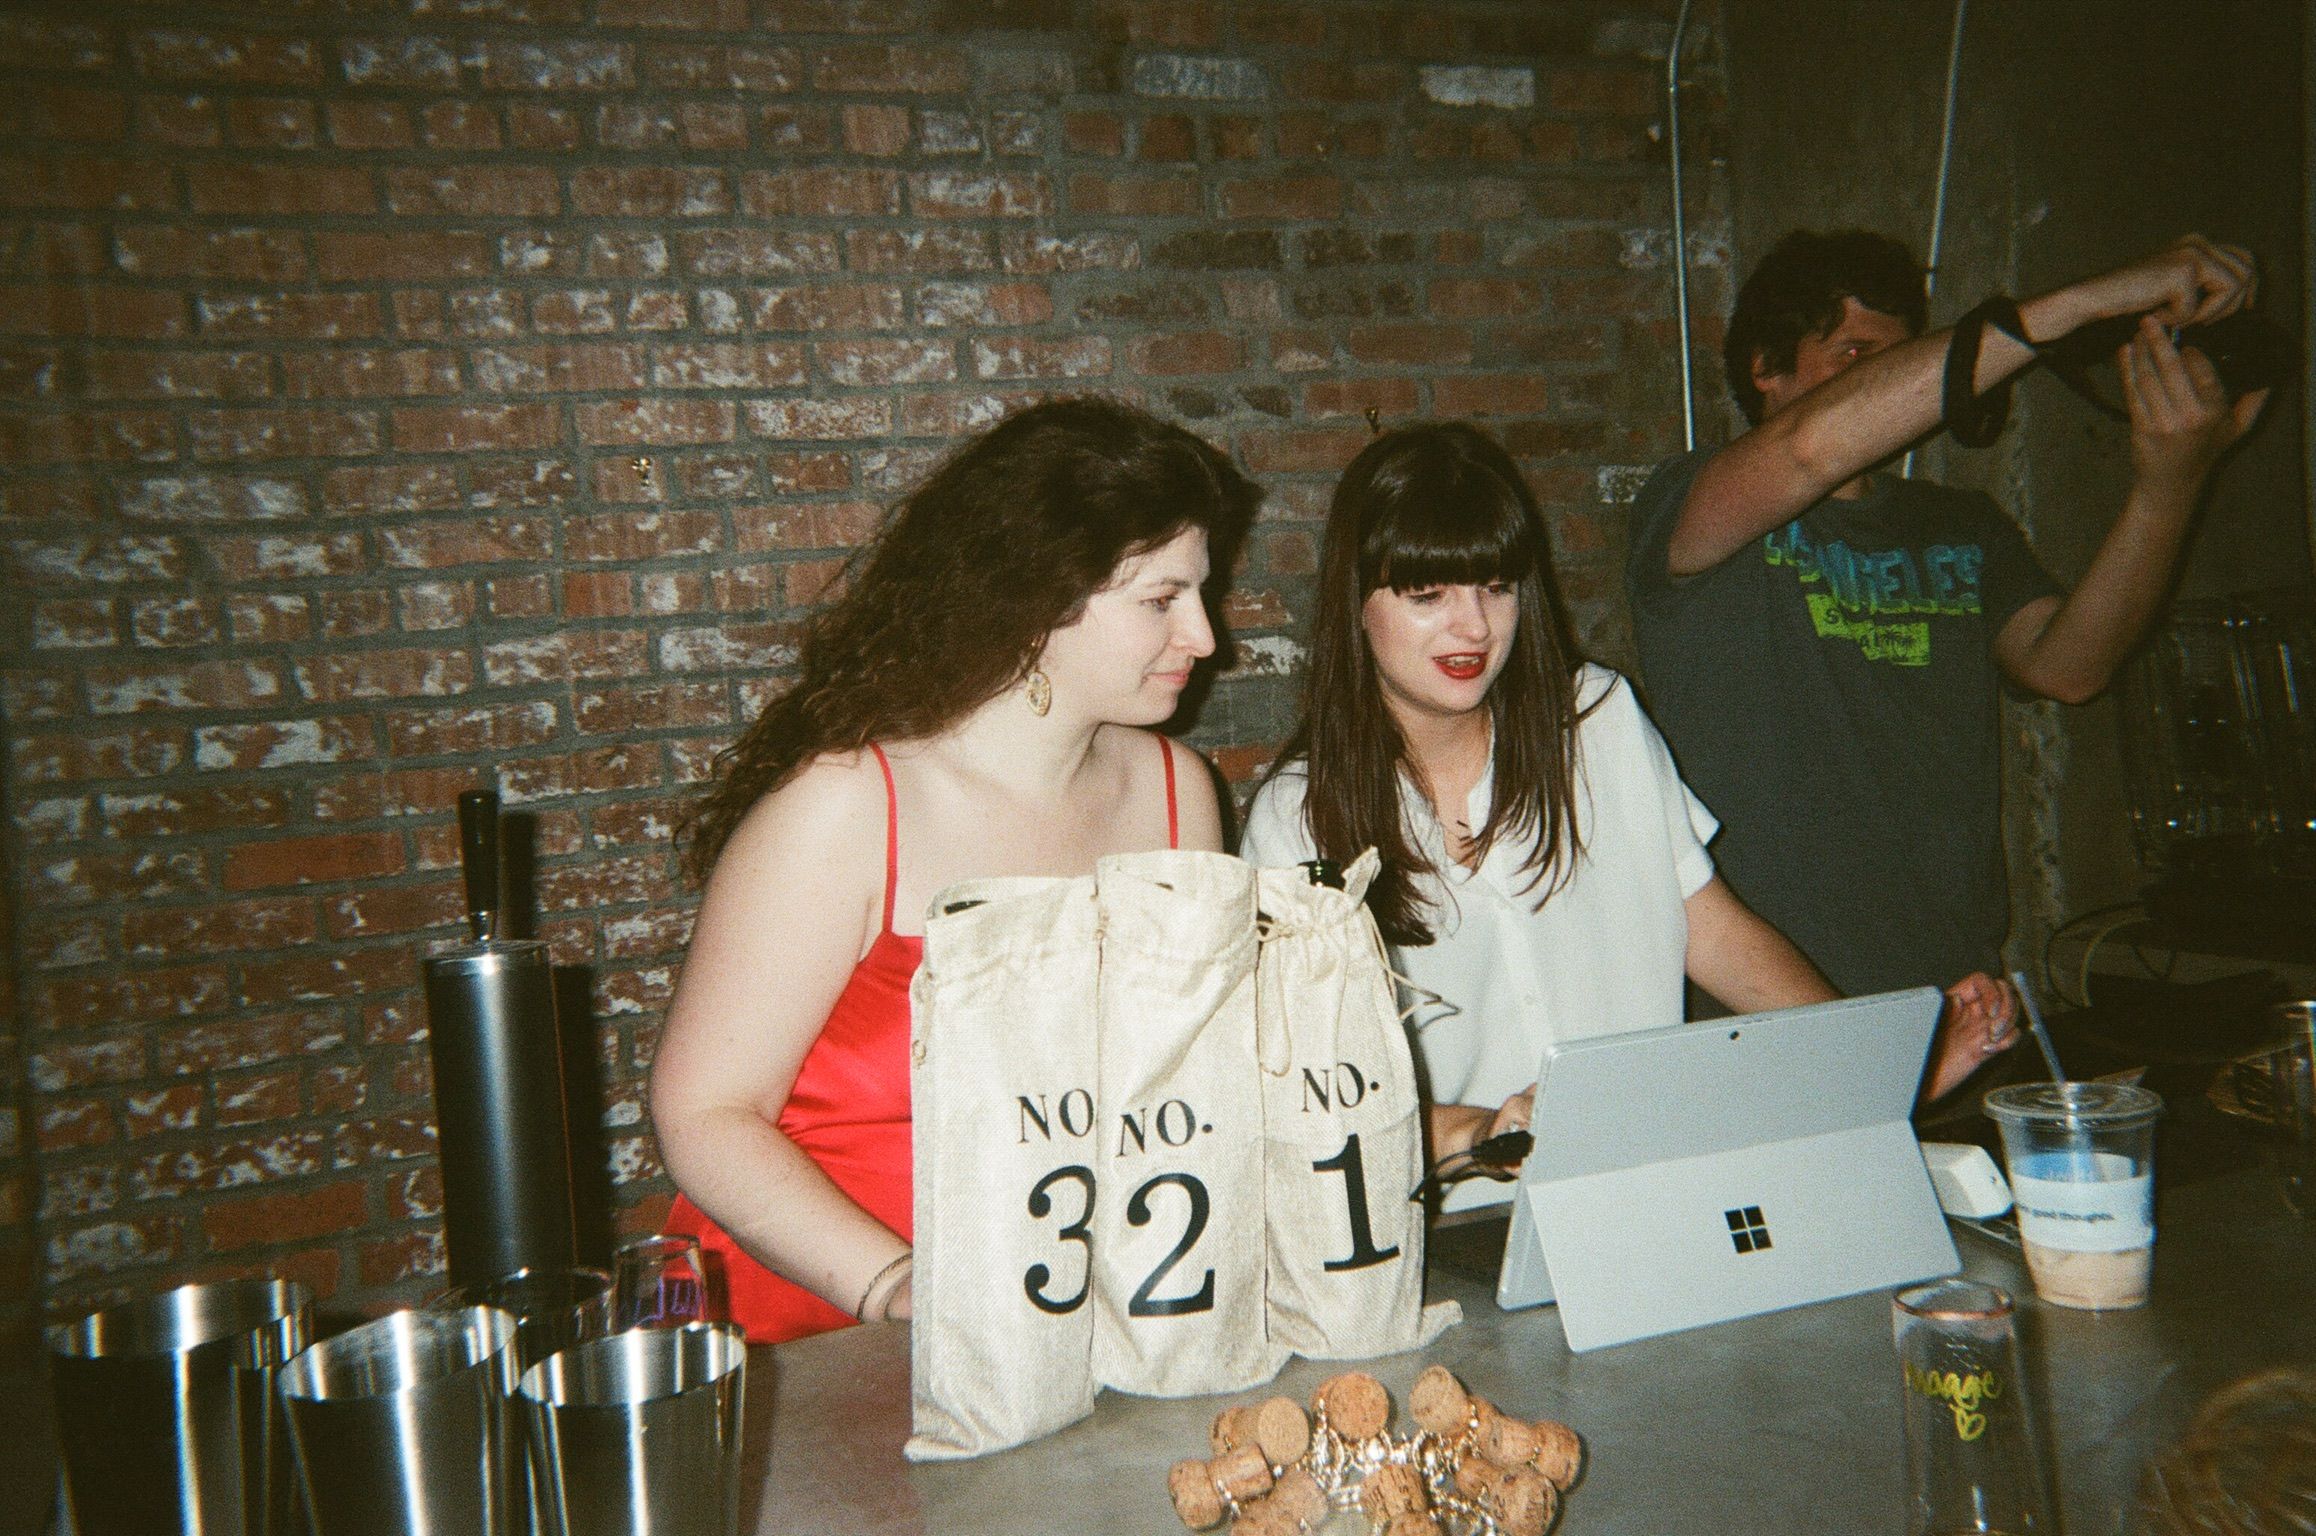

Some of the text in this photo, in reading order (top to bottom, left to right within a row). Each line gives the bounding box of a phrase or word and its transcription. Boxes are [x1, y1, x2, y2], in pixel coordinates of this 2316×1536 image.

[1115, 1099, 1213, 1157] NO.
[1302, 1061, 1380, 1113] NO.
[1023, 1164, 1097, 1315] 3
[1126, 1172, 1215, 1317] 2
[1312, 1133, 1401, 1272] 1
